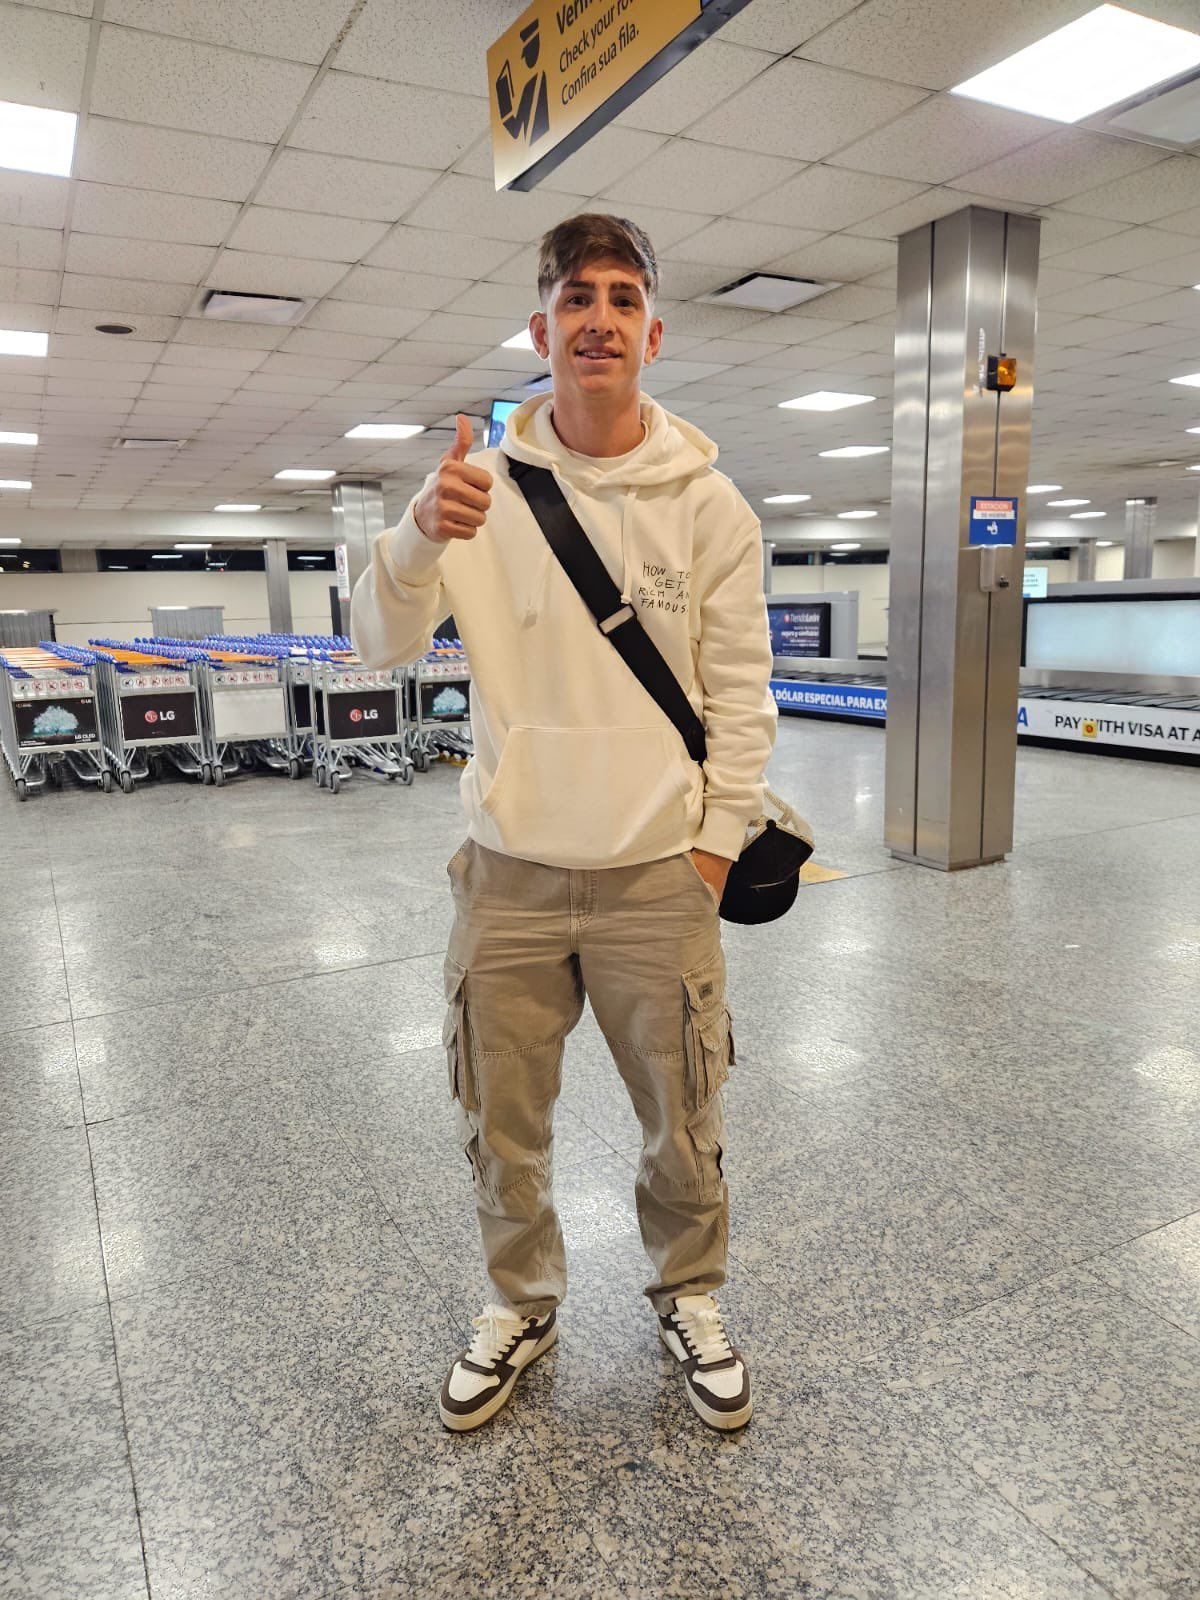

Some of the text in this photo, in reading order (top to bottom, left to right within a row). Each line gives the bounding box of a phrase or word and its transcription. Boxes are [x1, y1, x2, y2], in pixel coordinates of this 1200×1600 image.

[559, 0, 633, 73] Check your ro
[561, 22, 639, 105] Confira sua fila.
[642, 561, 666, 579] HOW
[655, 577, 685, 590] GET
[775, 688, 804, 703] DÓLAR
[805, 692, 847, 707] ESPECIAL
[847, 696, 873, 710] PARA
[160, 711, 176, 721] LG
[364, 709, 379, 720] LG
[1055, 715, 1081, 729] PAY
[1127, 720, 1164, 738] VISA
[1167, 726, 1189, 741] AT
